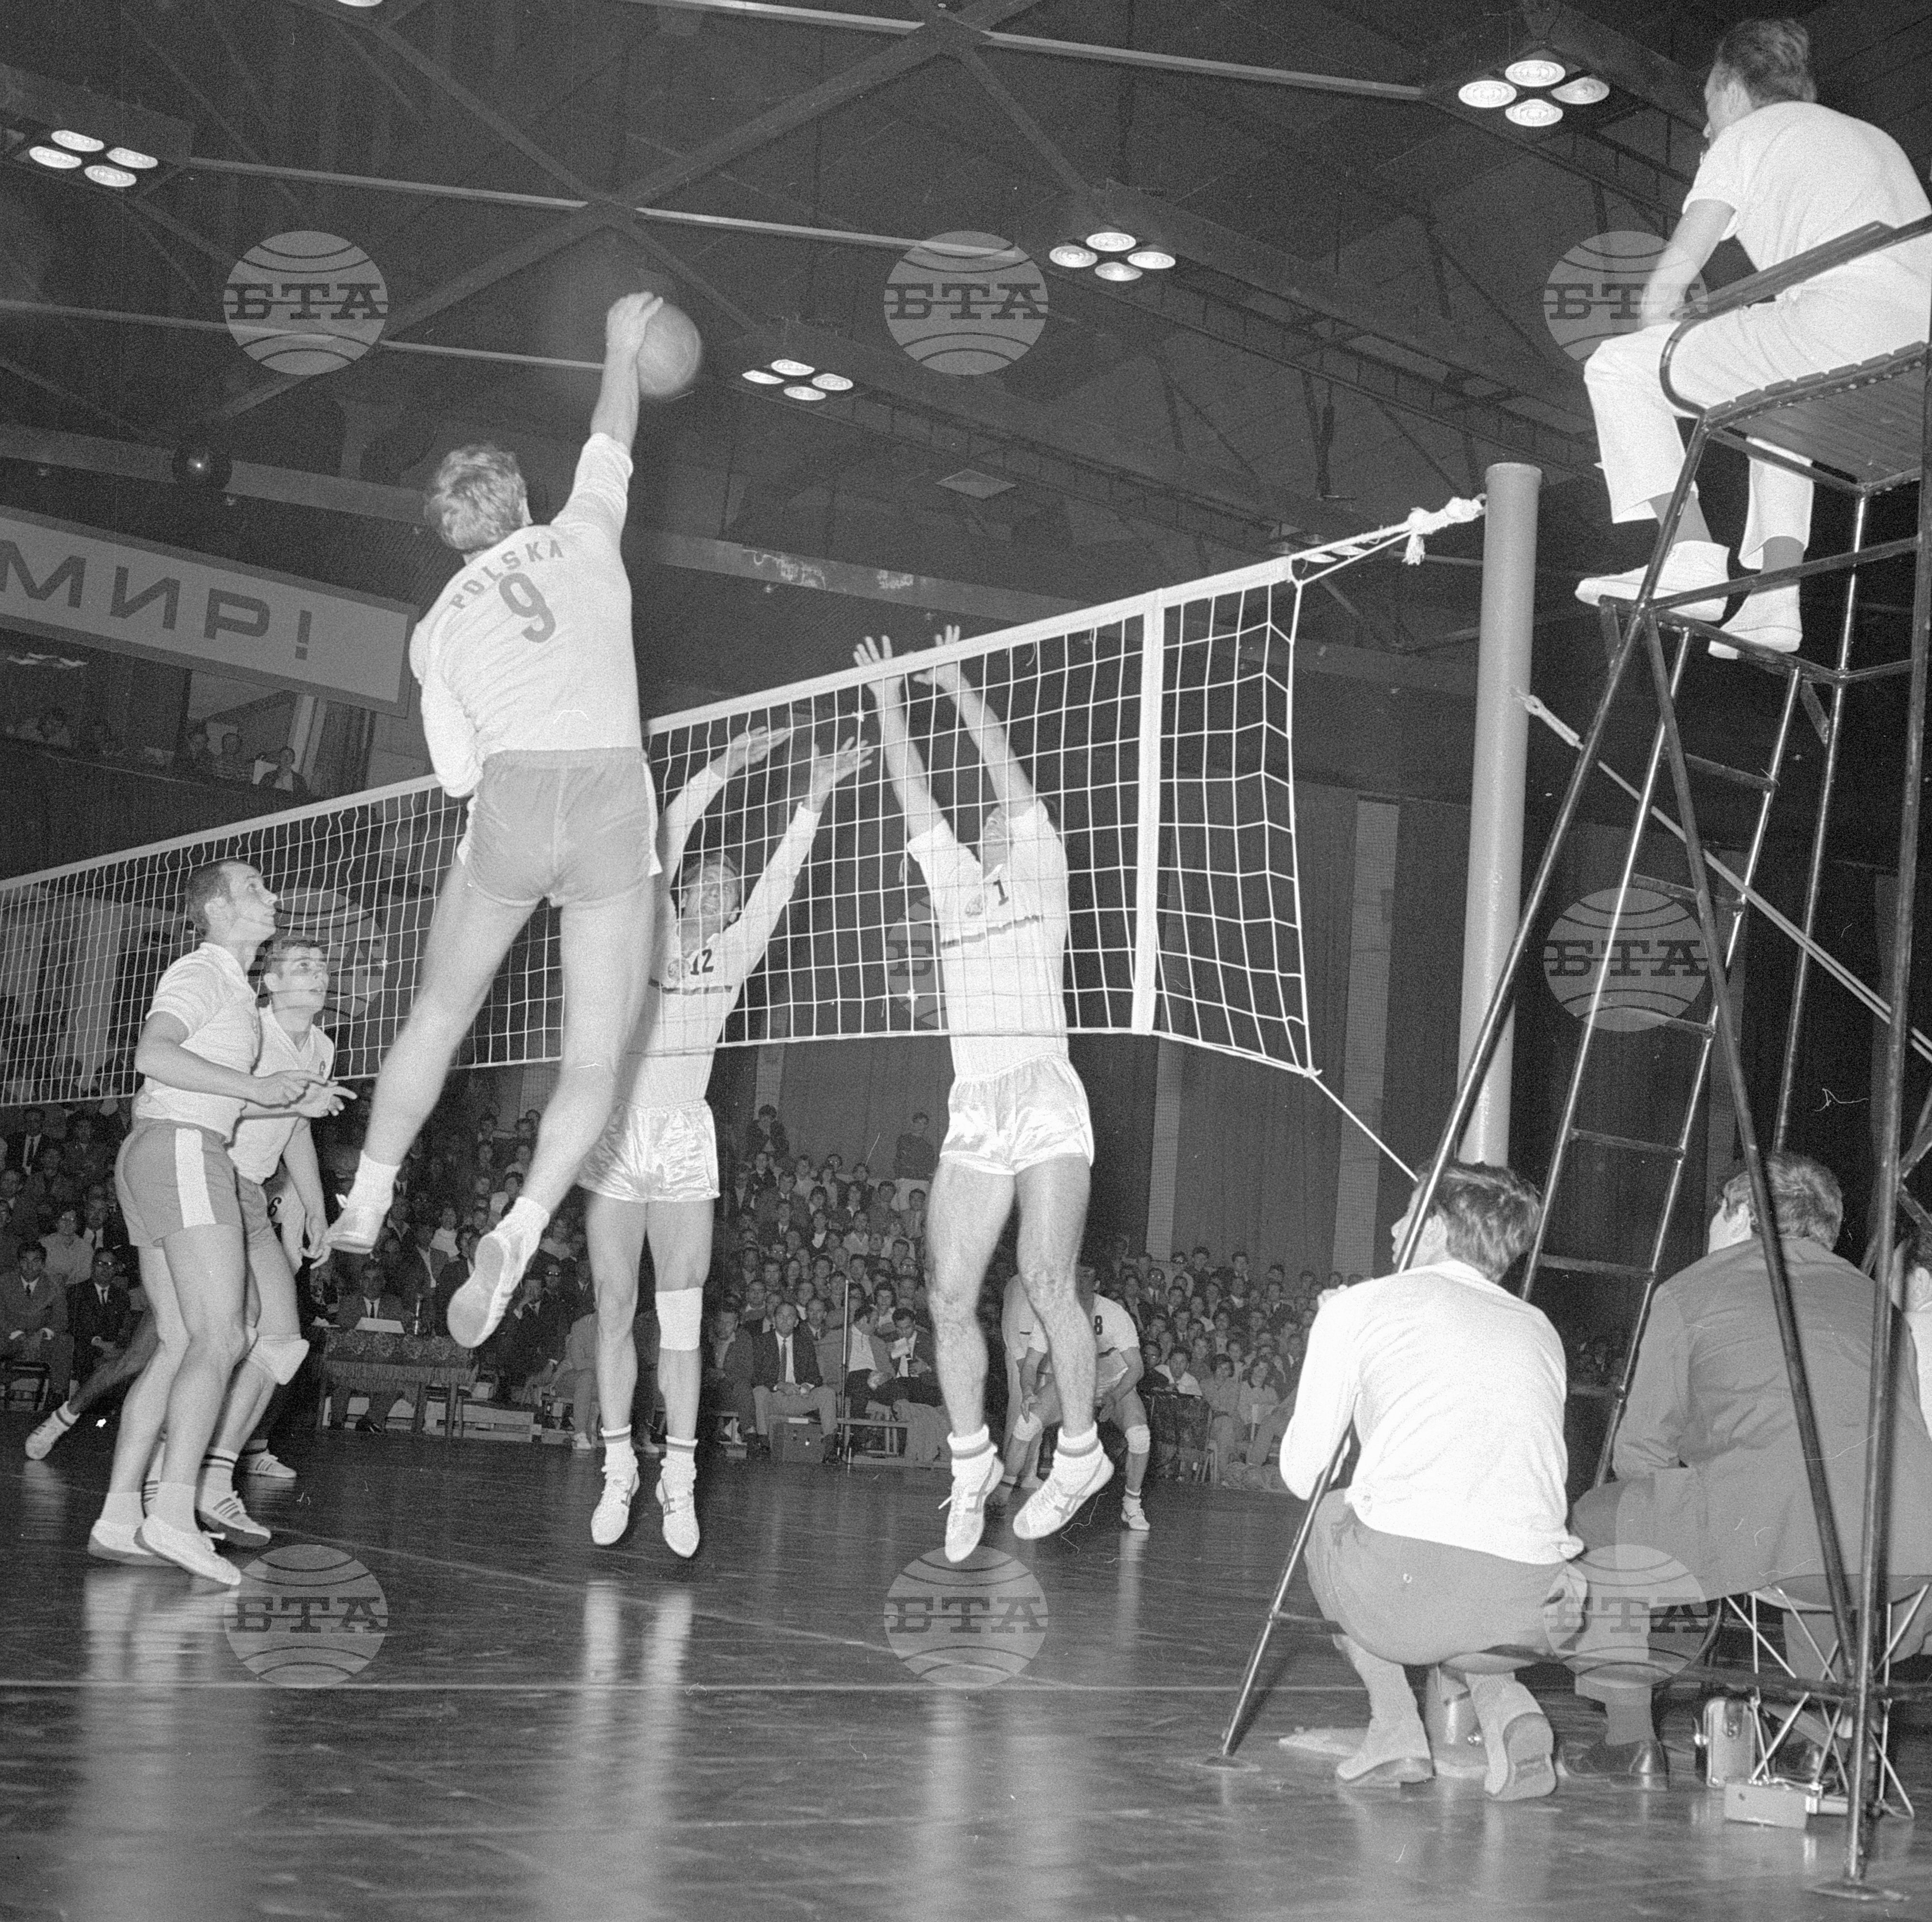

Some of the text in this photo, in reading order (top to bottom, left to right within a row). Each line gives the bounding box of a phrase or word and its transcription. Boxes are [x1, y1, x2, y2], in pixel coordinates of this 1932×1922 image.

[449, 540, 564, 609] POLSKA
[499, 572, 556, 643] 9
[690, 949, 714, 975] 12
